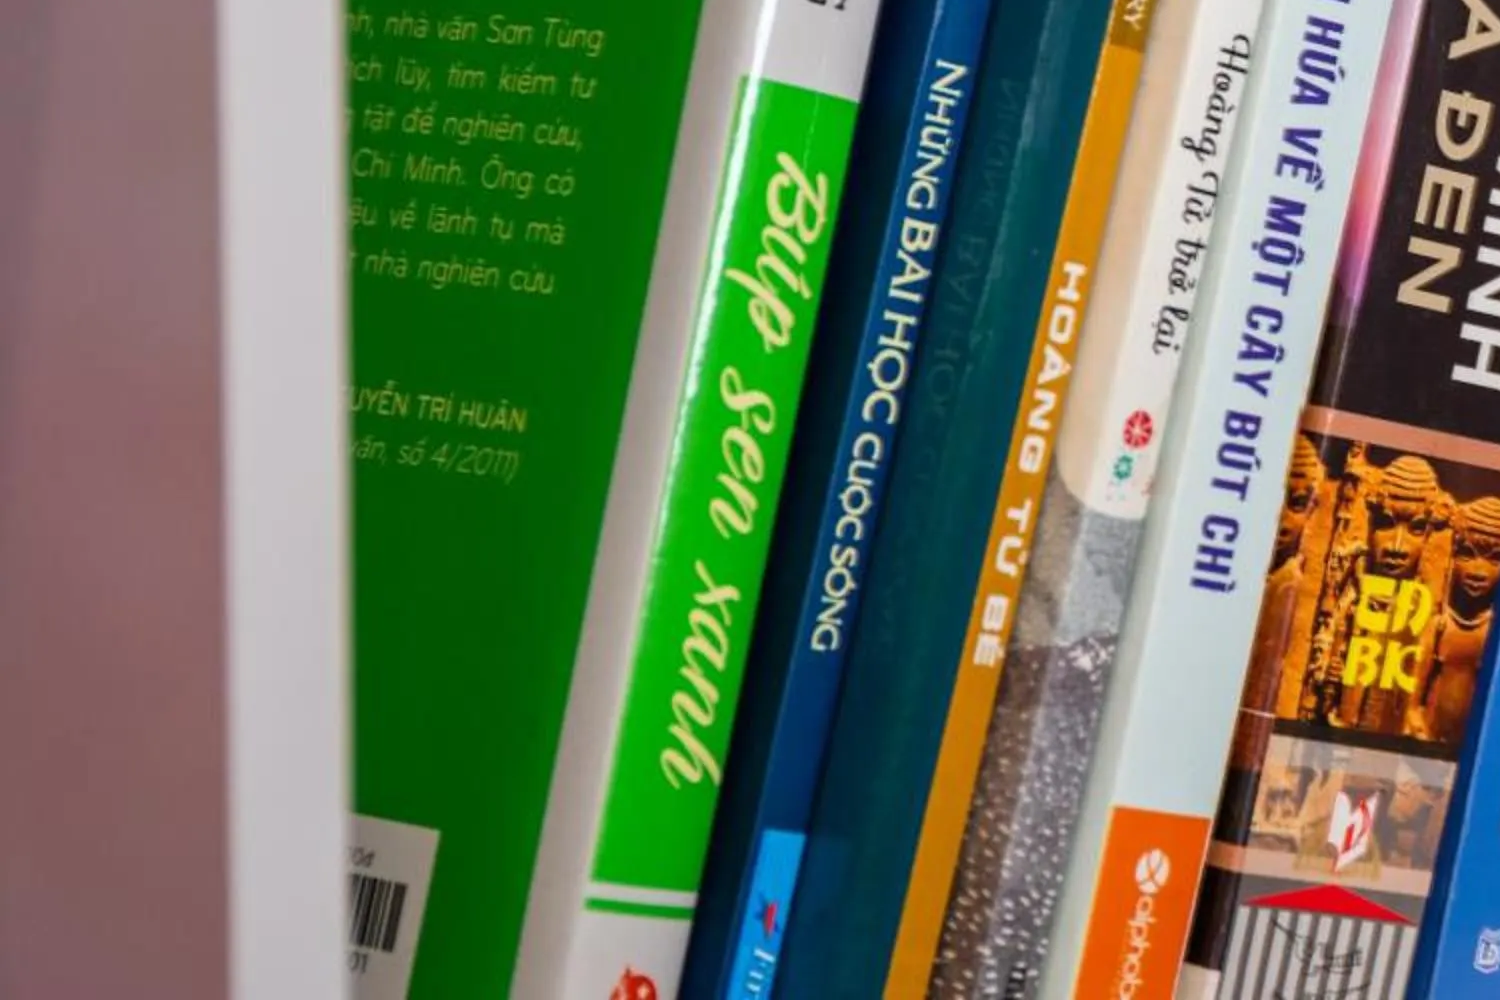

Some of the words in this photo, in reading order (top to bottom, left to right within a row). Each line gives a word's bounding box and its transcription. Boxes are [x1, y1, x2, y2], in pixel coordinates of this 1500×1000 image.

[1181, 34, 1251, 163] Hoàng
[1289, 15, 1346, 106] HỨA
[1183, 170, 1219, 226] Tử
[1273, 126, 1325, 192] VỀ
[1397, 90, 1495, 314] ĐEN
[726, 152, 829, 354] Búp
[1167, 237, 1207, 296] trở
[1253, 193, 1307, 297] MỘT
[861, 309, 914, 424] HỌC
[1018, 260, 1087, 475] HOÀNG
[1152, 305, 1190, 356] lại
[1231, 303, 1288, 400] CÂY
[710, 366, 777, 540] sen
[1210, 412, 1263, 503] BÚT
[1189, 510, 1241, 597] CHÌ
[661, 560, 743, 790] xanh
[972, 595, 1010, 668] BÉ
